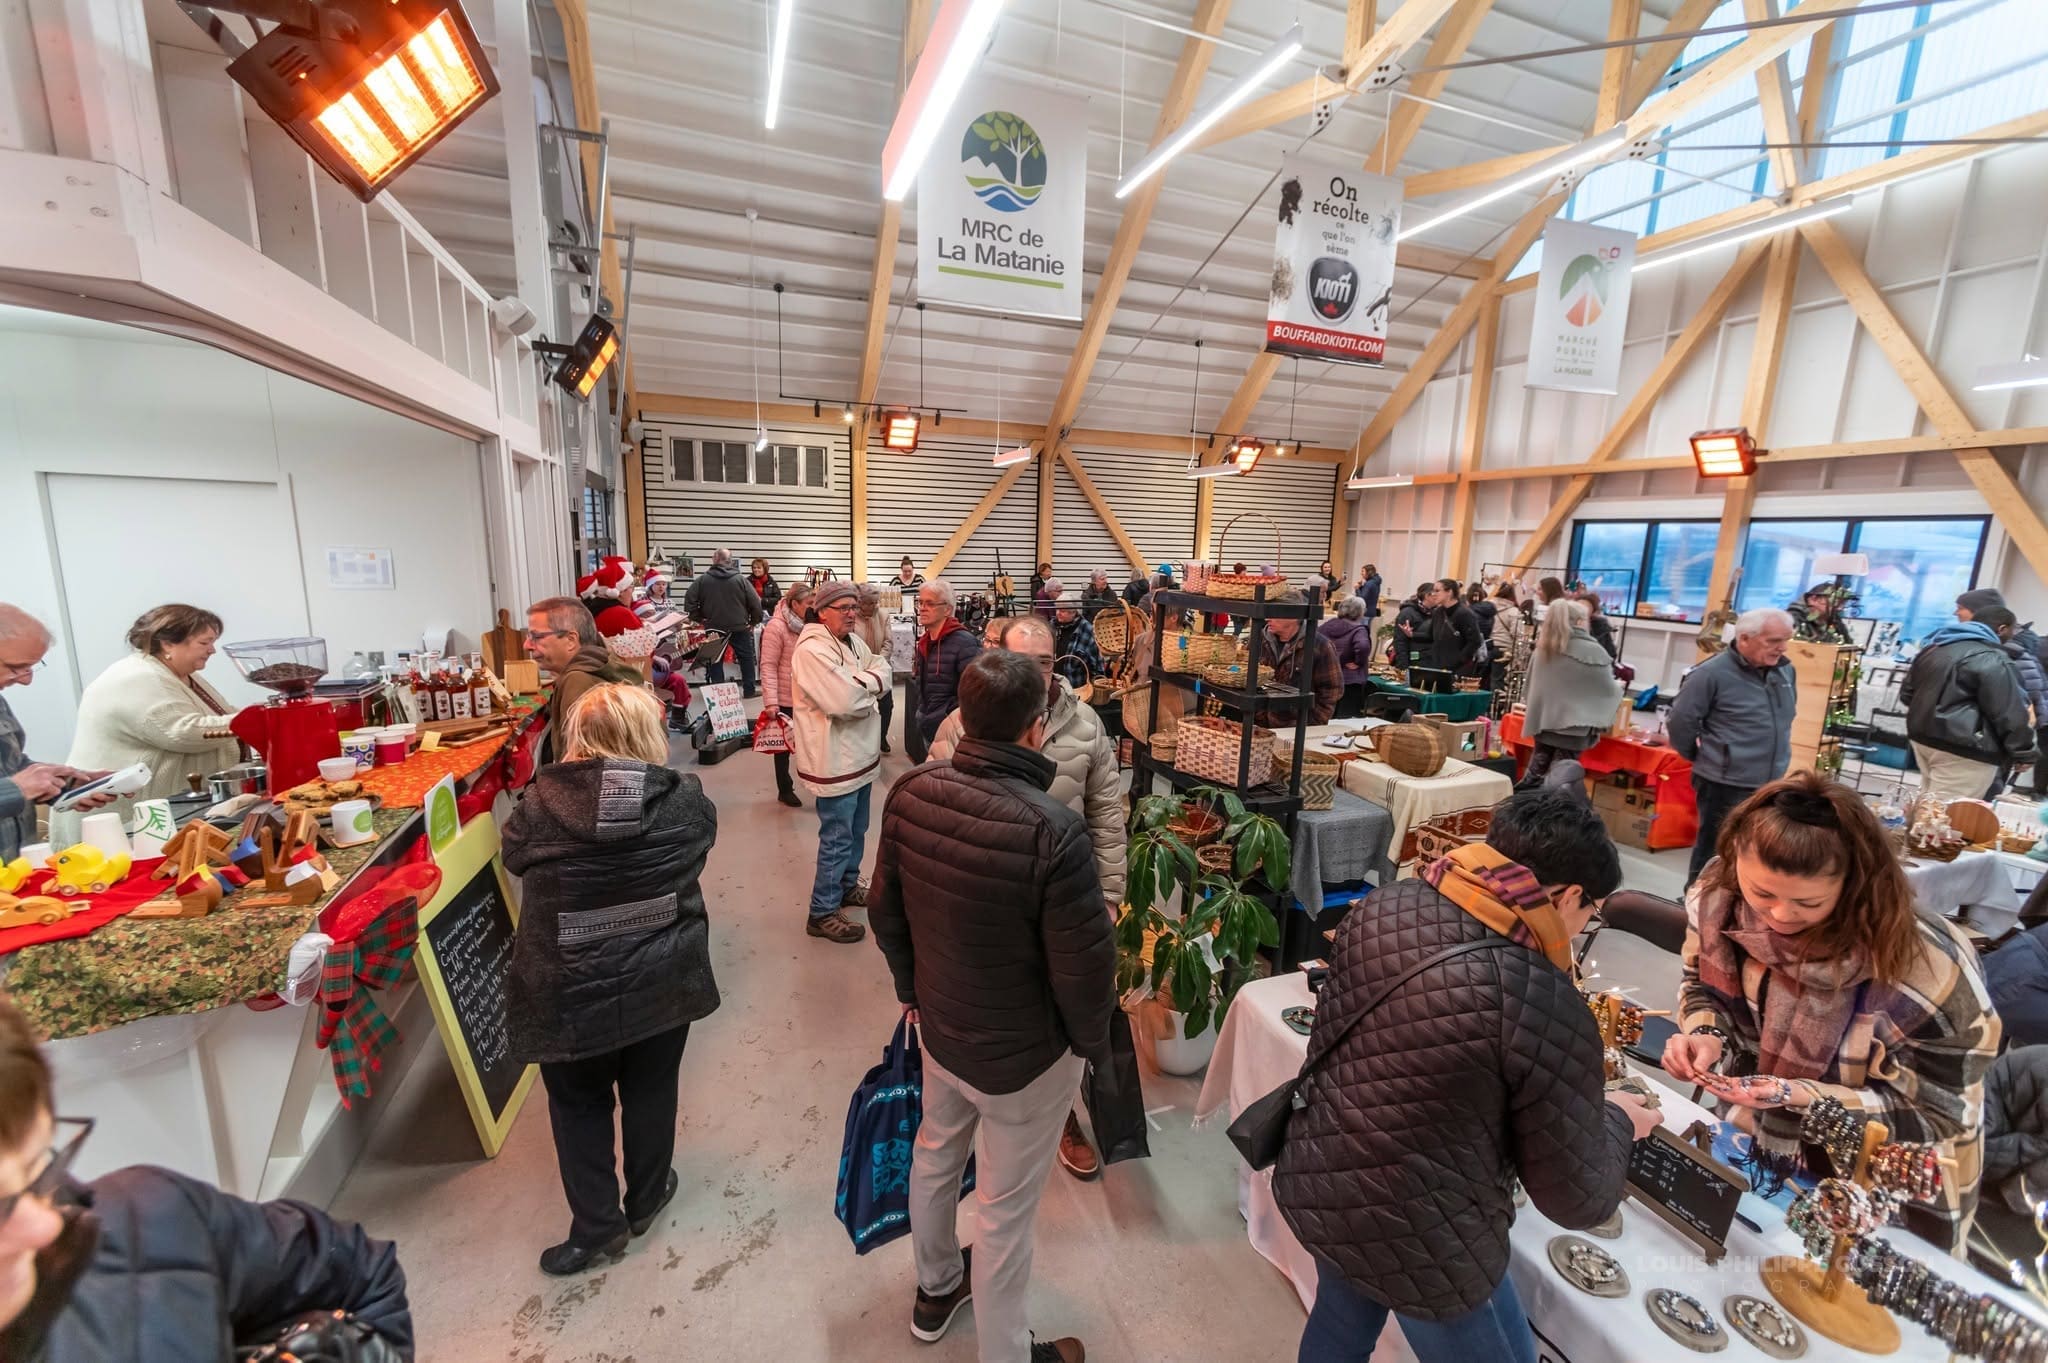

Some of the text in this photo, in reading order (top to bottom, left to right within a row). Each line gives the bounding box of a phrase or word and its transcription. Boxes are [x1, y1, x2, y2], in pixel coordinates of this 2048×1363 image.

[1329, 176, 1358, 202] On
[1312, 199, 1370, 225] récolte
[961, 217, 1044, 248] MRC de
[1322, 231, 1338, 245] que
[1335, 222, 1345, 230] ce
[937, 237, 1065, 277] La Matanie
[1325, 244, 1349, 257] sème
[1314, 277, 1353, 304] KIOTI
[1273, 325, 1383, 354] BOUFFARDKIOTI.COM
[1556, 346, 1597, 358] PUBLIC
[452, 974, 471, 996] Moka
